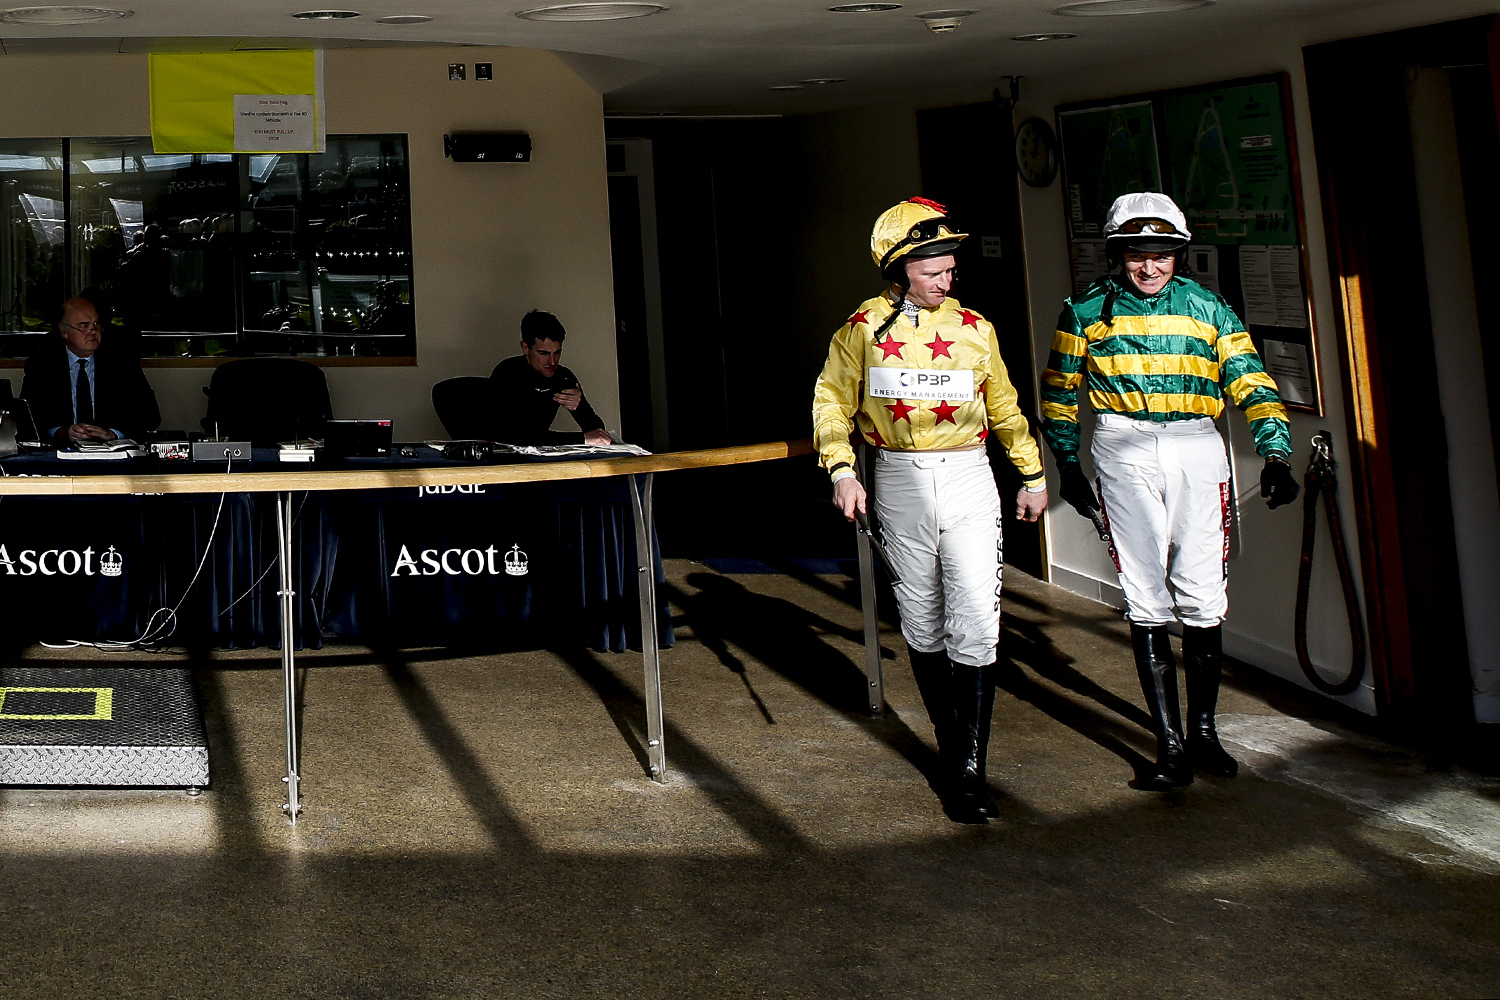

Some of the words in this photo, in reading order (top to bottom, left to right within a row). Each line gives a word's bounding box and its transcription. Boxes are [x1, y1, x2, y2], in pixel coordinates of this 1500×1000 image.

[874, 388, 908, 397] ENERGY
[911, 391, 969, 399] MANAGEMENT
[391, 544, 500, 577] Ascot
